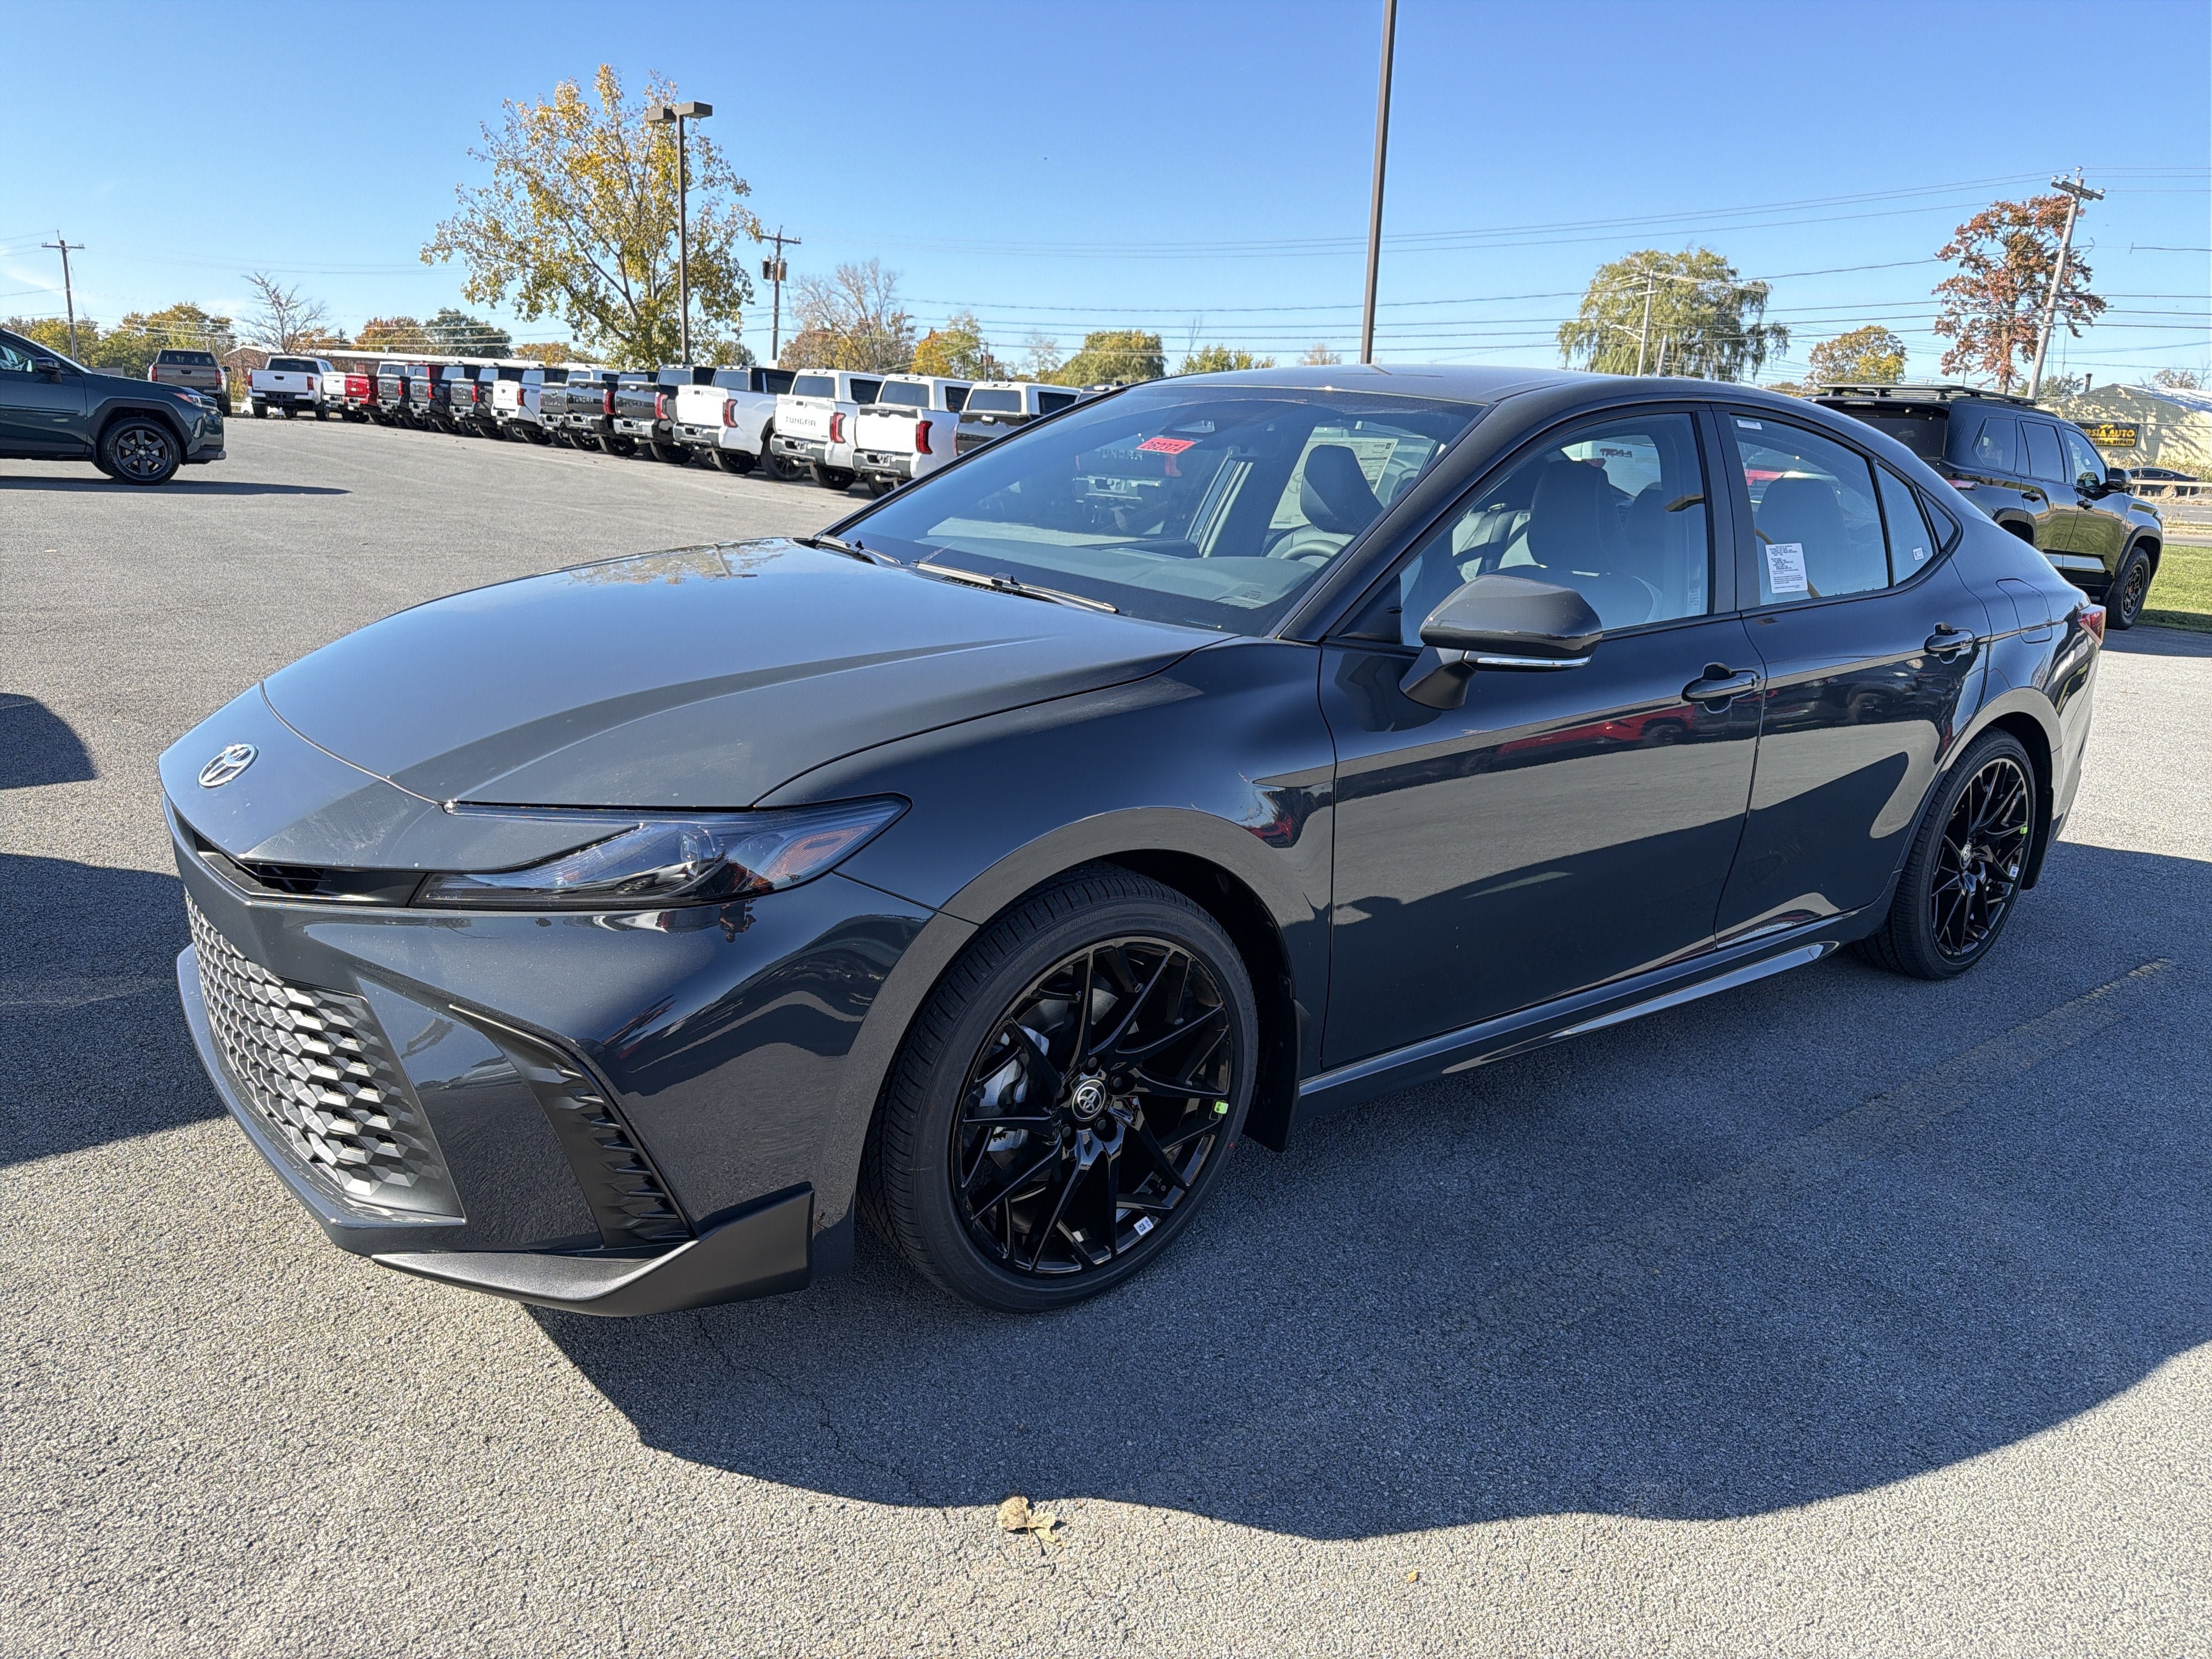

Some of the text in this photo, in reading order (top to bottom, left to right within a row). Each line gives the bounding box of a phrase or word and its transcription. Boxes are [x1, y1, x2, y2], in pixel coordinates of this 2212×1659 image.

[572, 396, 594, 404] TUNDRA
[786, 415, 816, 427] TUNDRA
[2083, 428, 2135, 437] RSIA AUTO
